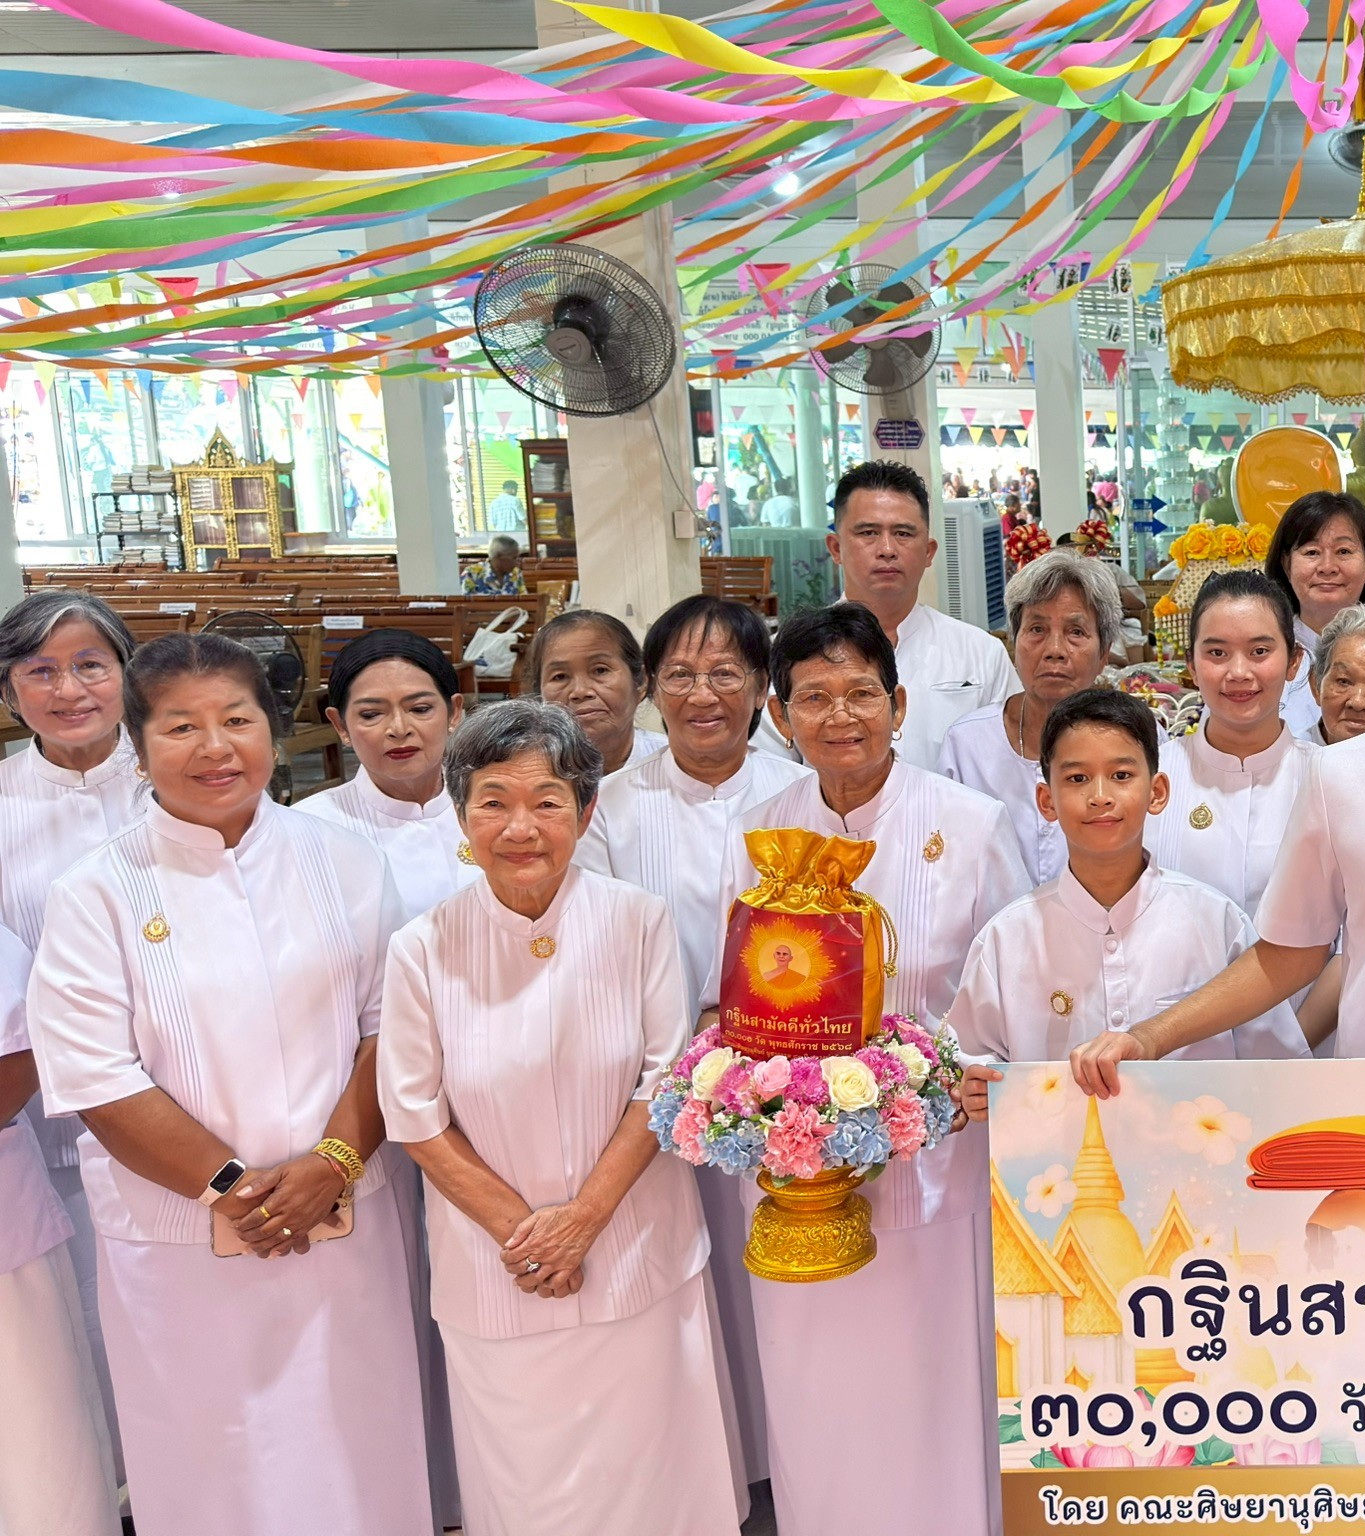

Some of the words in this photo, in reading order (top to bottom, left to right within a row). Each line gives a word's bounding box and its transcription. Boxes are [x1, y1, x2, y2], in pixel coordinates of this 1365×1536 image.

[725, 1006, 852, 1035] กฐินสามัคคีทั่วไทย
[755, 1035, 766, 1046] วัด
[768, 1039, 818, 1051] พุทธศักราช
[821, 1042, 852, 1051] ๒๕๖๘
[1031, 1390, 1318, 1447] ๓๐,๐๐๐
[1043, 1489, 1104, 1521] โดย
